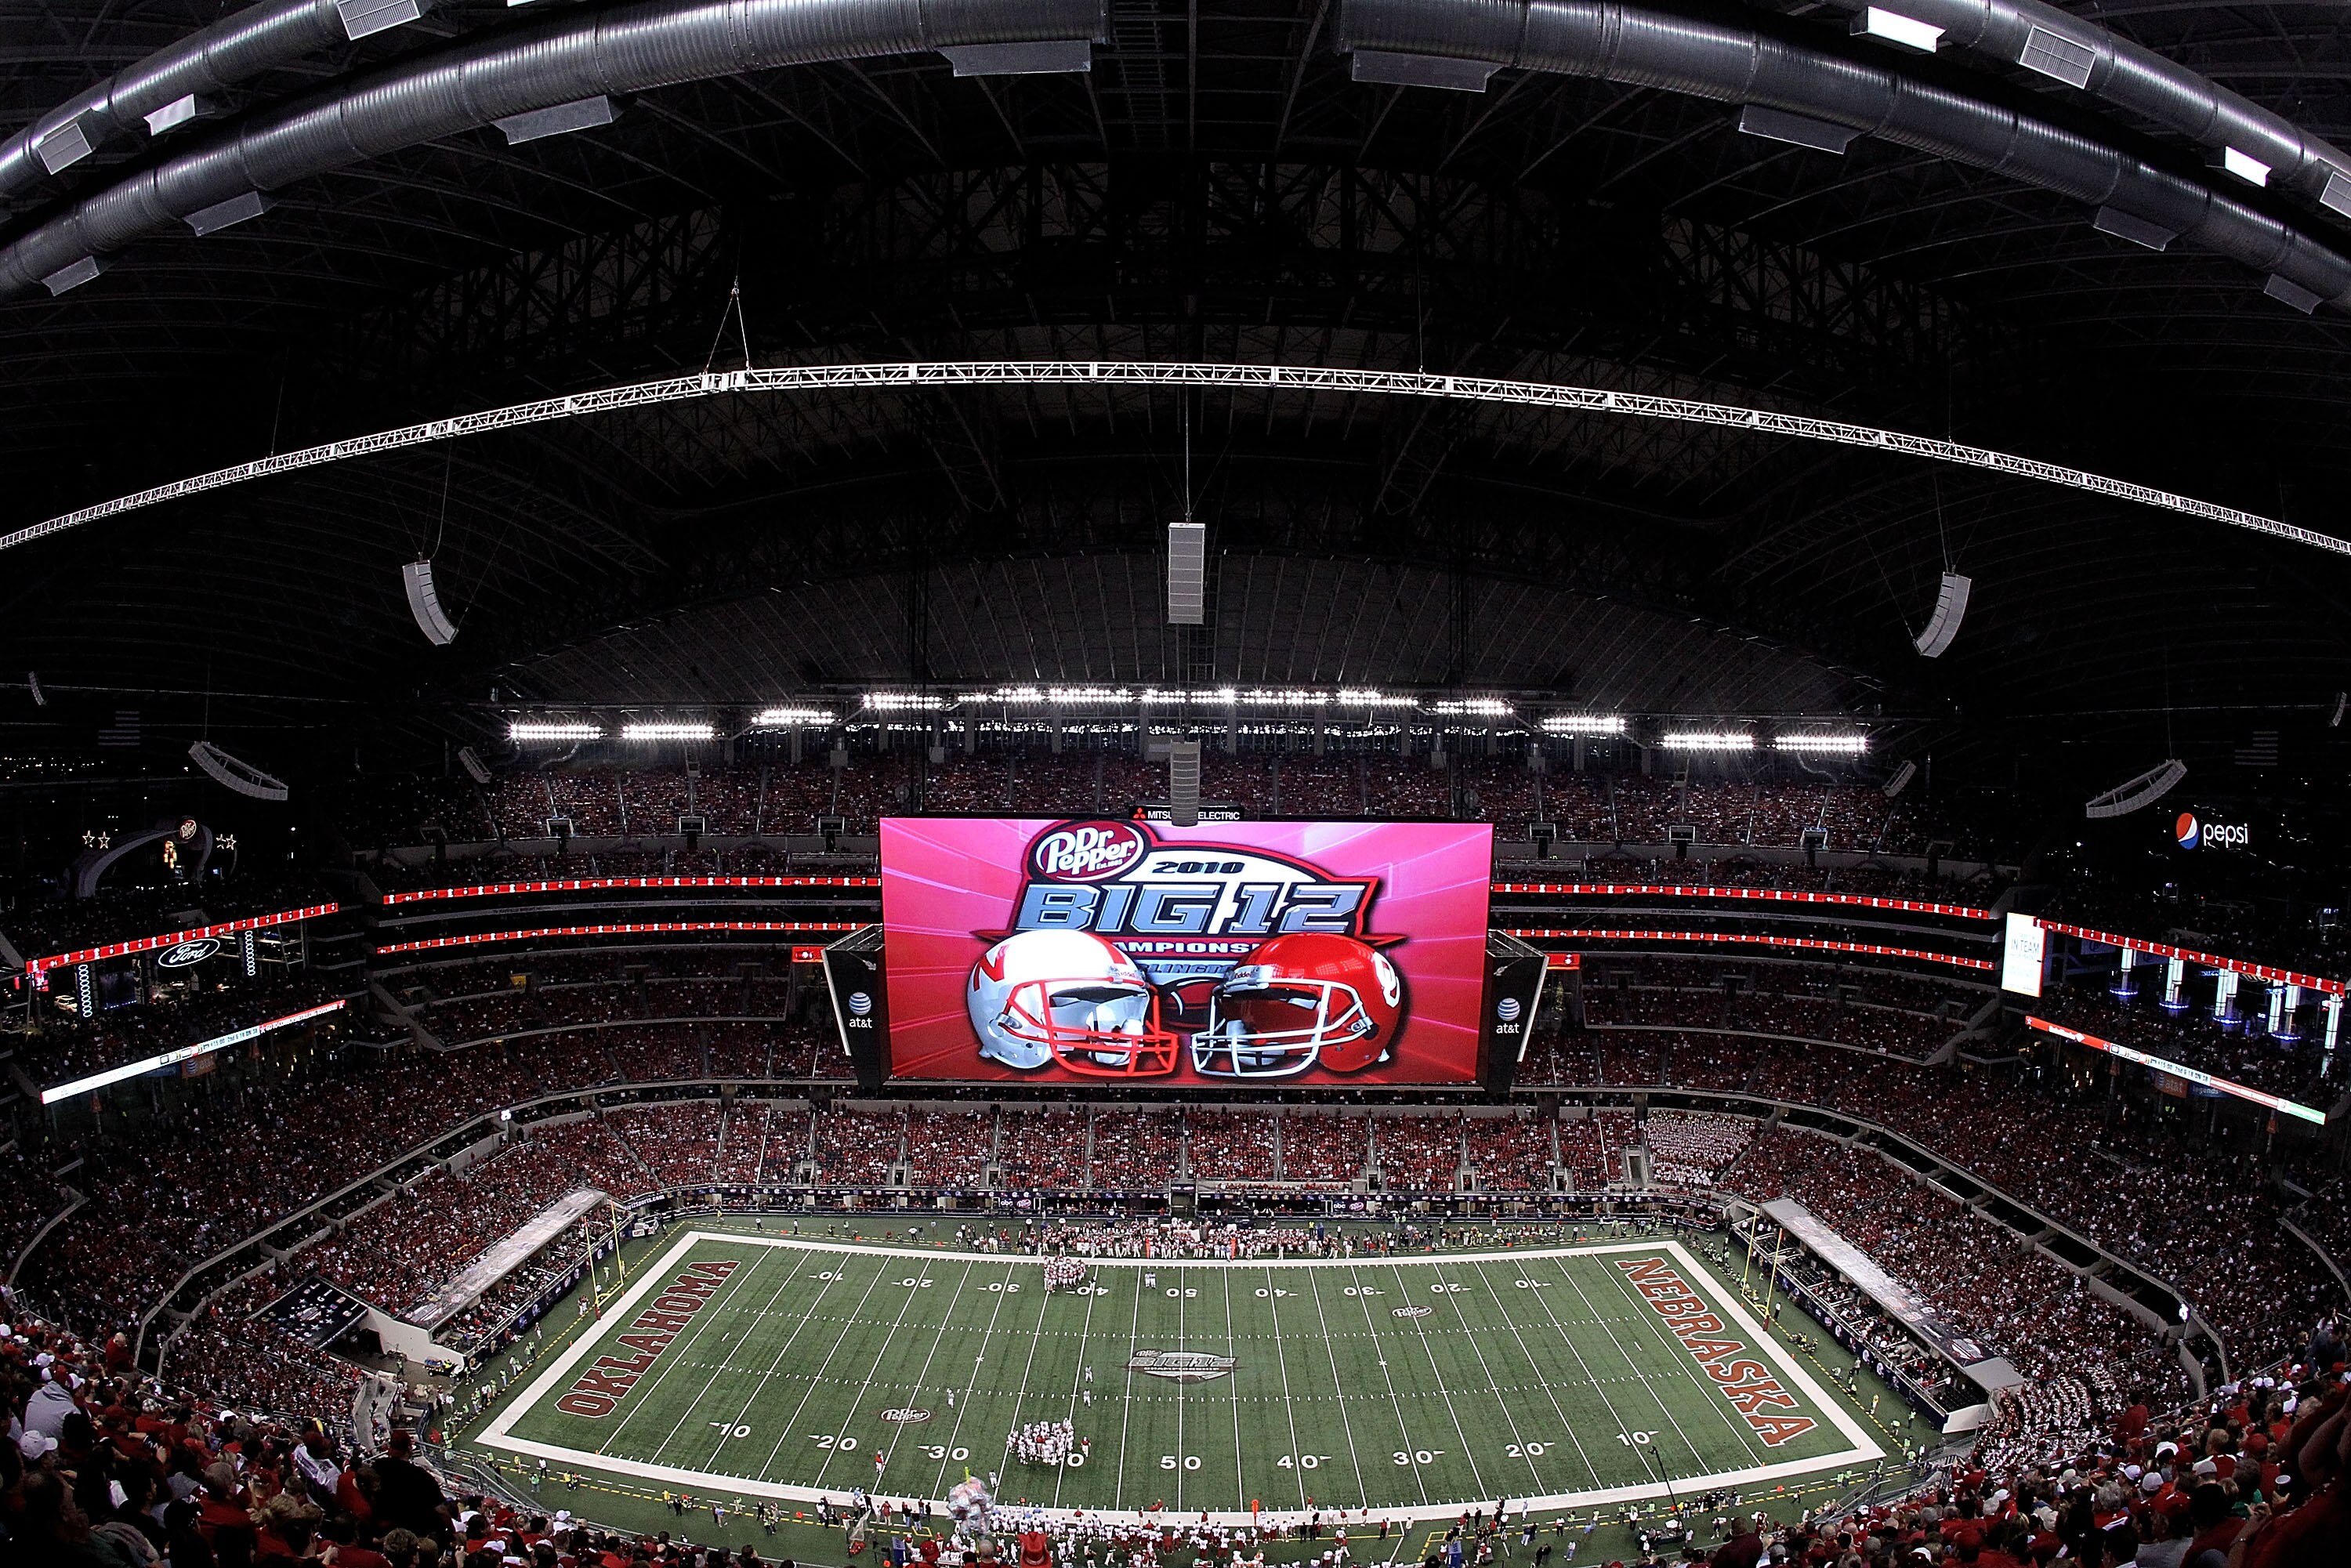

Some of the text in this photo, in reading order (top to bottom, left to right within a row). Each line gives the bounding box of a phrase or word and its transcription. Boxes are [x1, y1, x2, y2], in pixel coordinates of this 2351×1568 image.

[1198, 812, 1240, 820] ELECTRIC
[1074, 827, 1114, 853] Dr
[2203, 823, 2248, 849] pepsi
[1152, 861, 1245, 874] 2010
[1016, 884, 1365, 933] BIG 12
[169, 943, 210, 964] Ford
[2020, 940, 2040, 954] TEAM
[849, 1017, 872, 1029] at&t
[1496, 1023, 1520, 1034] at&t
[818, 1271, 844, 1282] 10
[901, 1277, 933, 1288] 20
[987, 1283, 1020, 1292] 30
[1430, 1283, 1461, 1293] 20
[1515, 1279, 1541, 1289] 10
[1077, 1286, 1109, 1296] 40
[1166, 1288, 1197, 1298] 50
[1255, 1288, 1288, 1298] 40
[1344, 1287, 1375, 1296] 30
[554, 1260, 741, 1418] OKLAHOMA
[1614, 1257, 1819, 1448] NEBRASKA
[1128, 1357, 1236, 1367] BIG 12
[882, 1409, 927, 1421] Pepper
[717, 1423, 751, 1438] 10
[816, 1436, 857, 1450] 20
[1616, 1431, 1651, 1447] 10
[928, 1446, 969, 1461] 30
[1505, 1442, 1545, 1458] 20
[1160, 1455, 1201, 1470] 50
[1277, 1454, 1318, 1469] 40
[1393, 1450, 1433, 1465] 30
